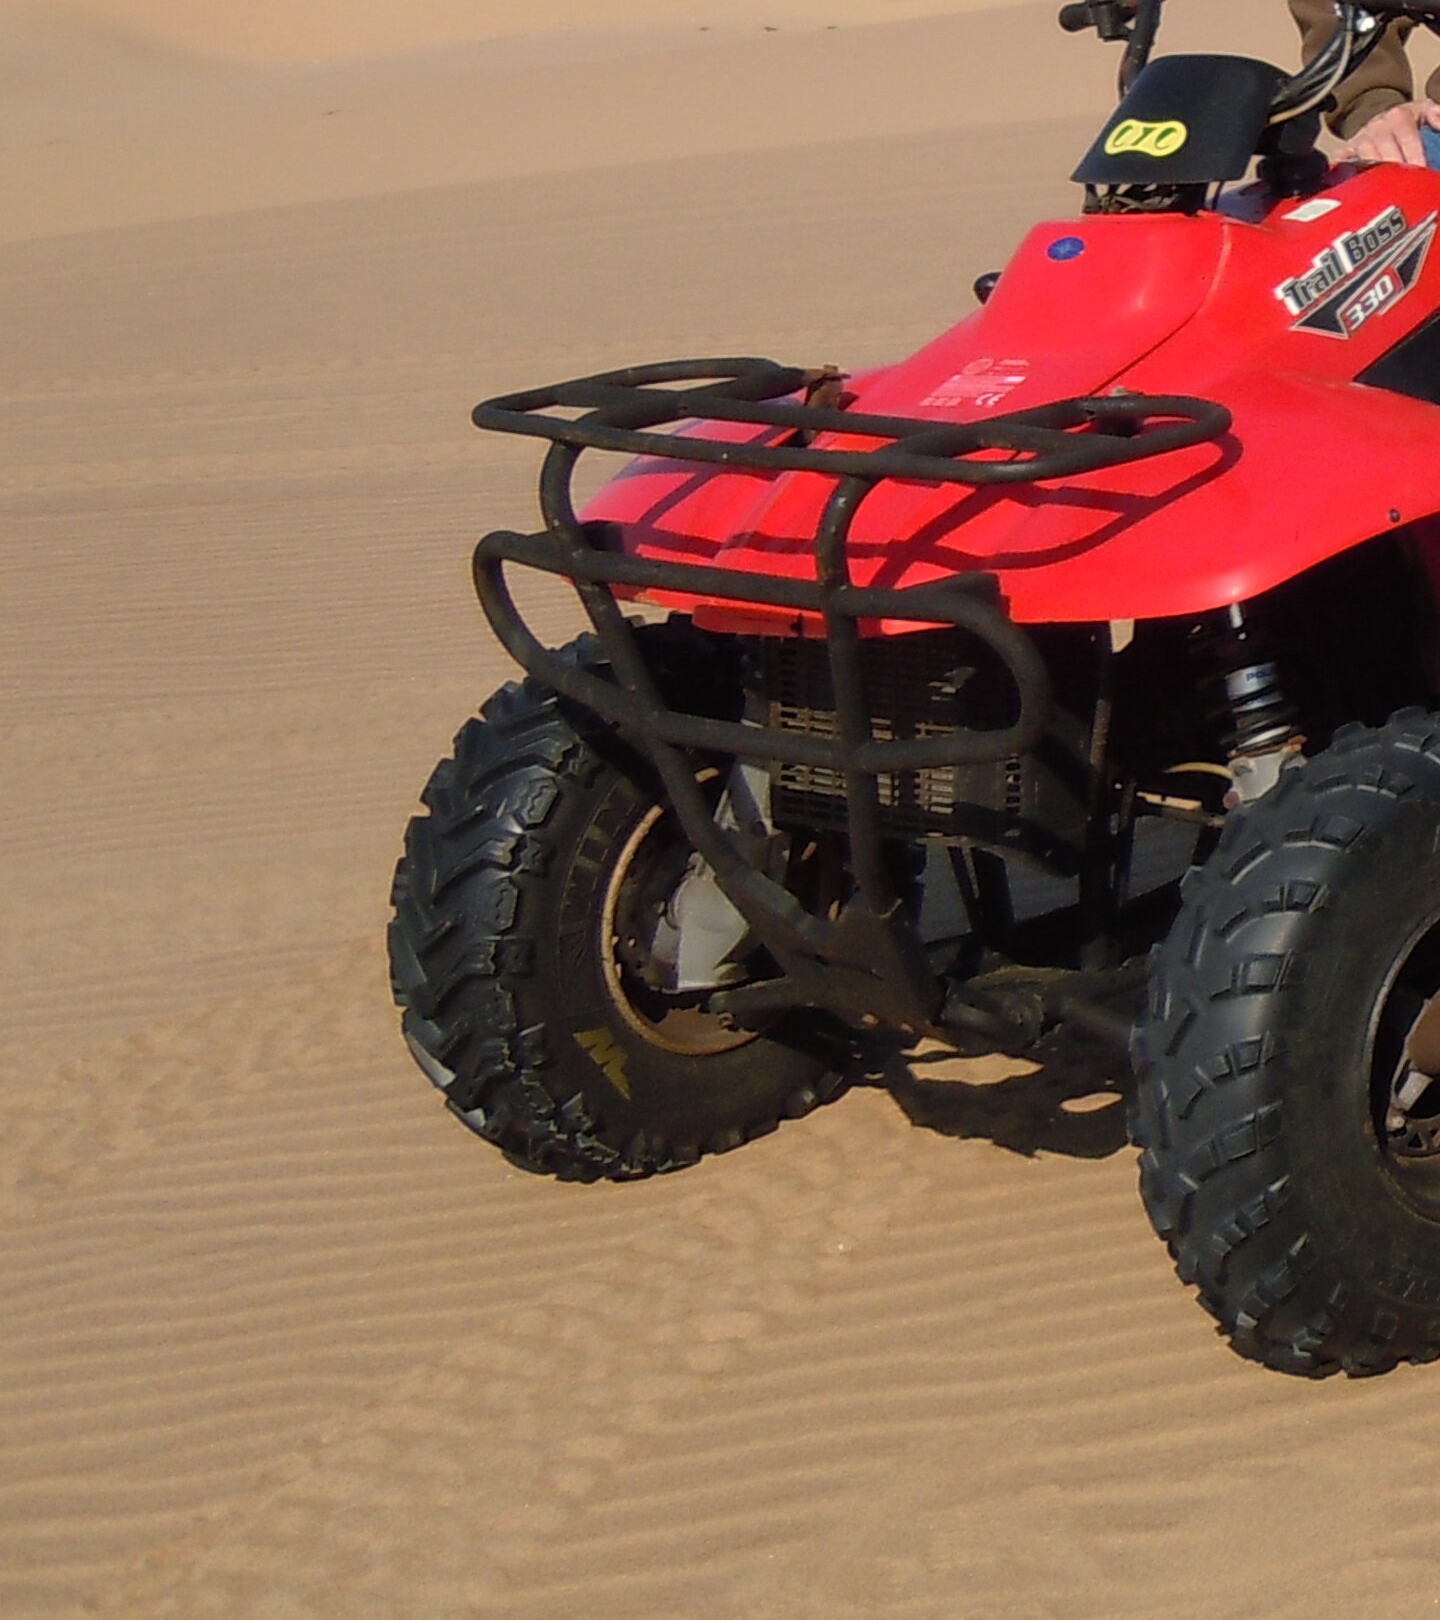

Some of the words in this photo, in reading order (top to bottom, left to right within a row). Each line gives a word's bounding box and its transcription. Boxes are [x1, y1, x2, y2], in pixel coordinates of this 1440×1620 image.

[1275, 248, 1345, 313] Trail
[1340, 207, 1406, 266] Boss
[1346, 275, 1395, 331] 330
